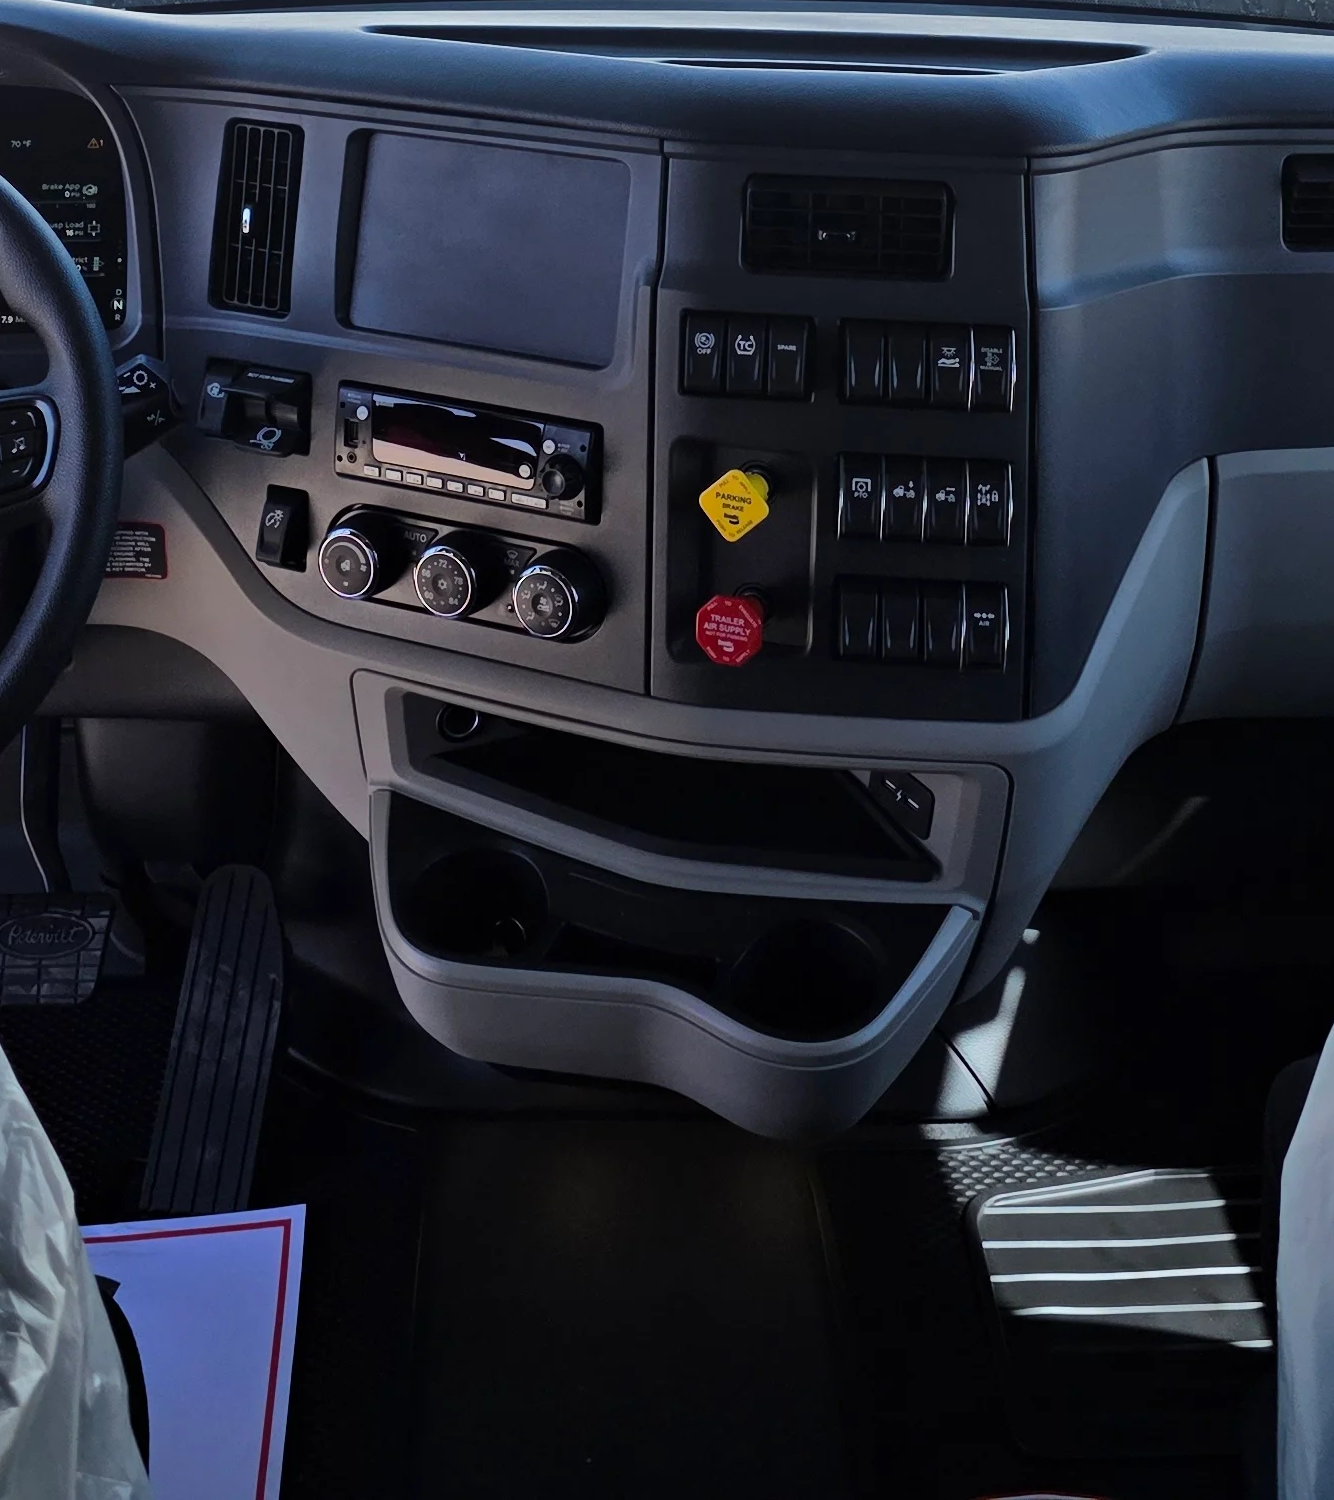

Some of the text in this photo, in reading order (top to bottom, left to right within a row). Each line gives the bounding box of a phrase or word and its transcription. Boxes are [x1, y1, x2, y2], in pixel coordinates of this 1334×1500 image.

[65, 183, 80, 191] App
[113, 301, 123, 310] N
[1, 315, 13, 323] 7.9
[697, 347, 712, 355] OFF
[738, 340, 753, 351] TC
[715, 492, 752, 505] PARKING
[722, 503, 744, 512] BRAKE
[403, 530, 427, 543] AUTO
[439, 559, 448, 569] 72
[504, 557, 520, 568] MAX
[711, 614, 745, 626] TRAILER
[703, 622, 751, 636] AIR SUPPLY
[8, 924, 83, 946] Peterbilt
